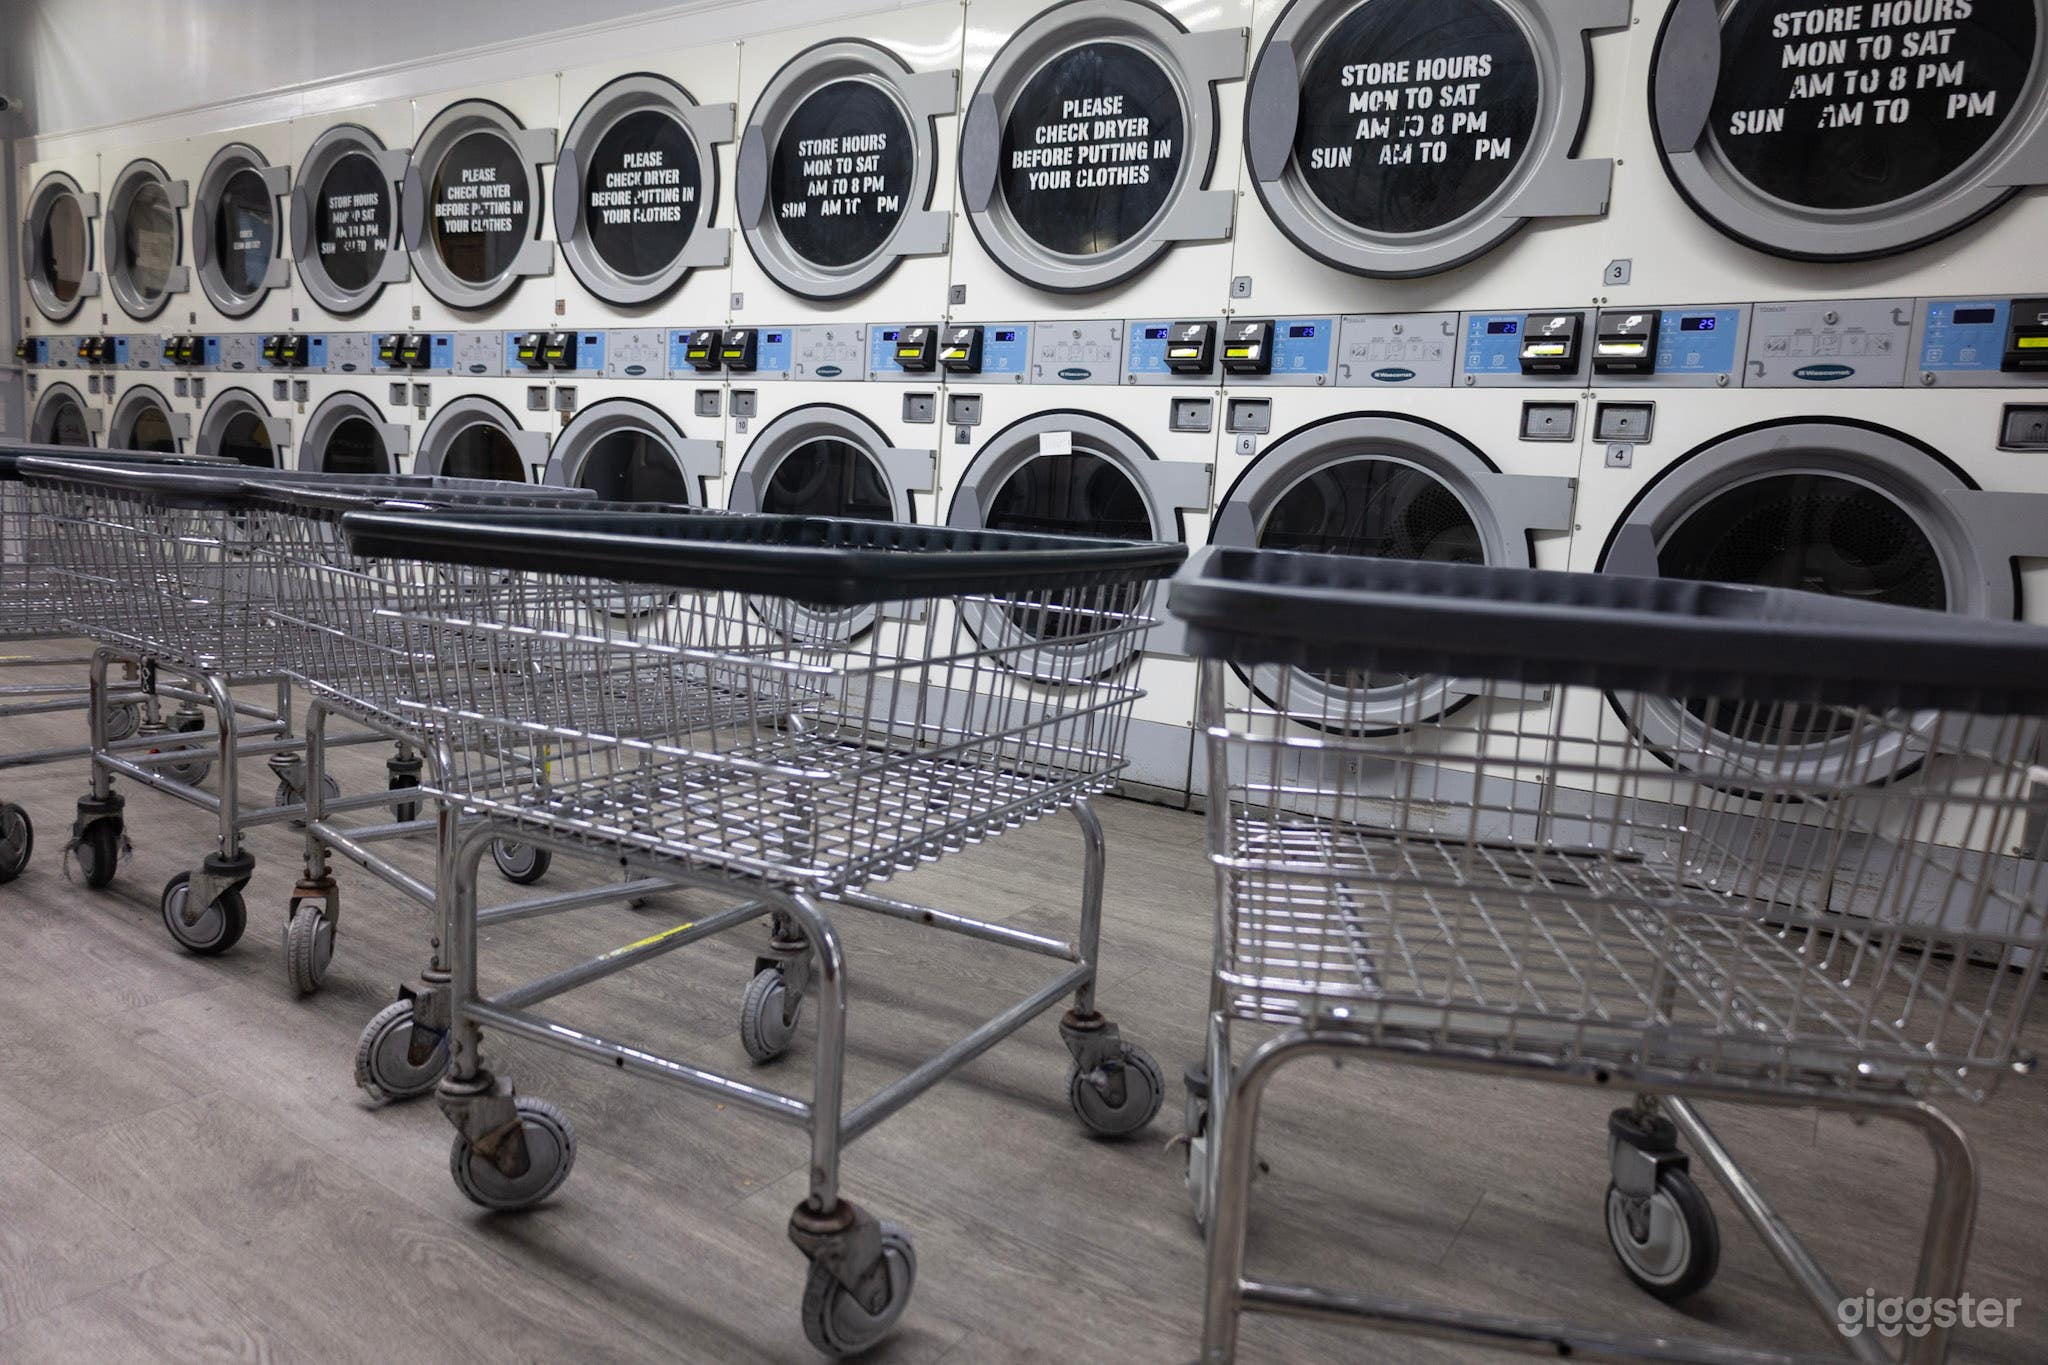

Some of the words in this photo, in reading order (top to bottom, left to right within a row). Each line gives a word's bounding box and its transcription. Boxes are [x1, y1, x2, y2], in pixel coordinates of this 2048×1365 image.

[1772, 5, 1863, 38] STORE
[1871, 0, 1972, 29] HOURS
[1781, 39, 1847, 69] MON
[1856, 34, 1892, 61] TO
[1900, 27, 1956, 58] SAT
[1341, 60, 1410, 87] STORE
[1416, 54, 1492, 81] HOURS
[1789, 72, 1835, 100] AM
[1844, 68, 1879, 95] TO
[1890, 66, 1907, 91] 8
[1916, 60, 1965, 89] PM
[1349, 88, 1399, 113] MON
[1405, 86, 1433, 110] TO
[1439, 83, 1481, 108] SAT
[1063, 96, 1124, 119] PLEASE
[1729, 108, 1784, 136] SUN
[1817, 102, 1864, 128] AM
[1873, 98, 1910, 125] TO
[1946, 90, 1996, 119] PM
[1035, 122, 1089, 145] CHECK
[1093, 117, 1150, 140] DRYER
[1355, 117, 1390, 140] AM
[1431, 113, 1445, 136] 8
[1451, 110, 1488, 135] PM
[798, 137, 839, 157] STORE
[842, 133, 887, 154] HOURS
[1310, 146, 1352, 169] SUN
[1378, 143, 1412, 165] AM
[1419, 141, 1447, 163] TO
[1475, 137, 1511, 161] PM
[623, 151, 663, 169] PLEASE
[1012, 147, 1073, 169] BEFORE
[1077, 141, 1149, 165] PUTTING
[1153, 139, 1172, 159] IN
[803, 159, 833, 177] MON
[836, 157, 853, 174] TO
[856, 155, 880, 173] SAT
[462, 168, 496, 183] PLEASE
[606, 171, 642, 188] CHECK
[644, 169, 680, 186] DRYER
[1029, 170, 1071, 191] YOUR
[1076, 165, 1150, 188] CLOTHES
[447, 185, 478, 200] CHECK
[480, 184, 510, 198] DRYER
[807, 180, 828, 197] AM
[832, 178, 848, 195] TO
[851, 177, 860, 194] 8
[863, 175, 885, 193] PM
[353, 192, 379, 207] HOURS
[591, 190, 632, 207] BEFORE
[682, 186, 694, 202] IN
[361, 208, 376, 221] SAT
[435, 203, 470, 217] BEFORE
[512, 200, 523, 214] IN
[603, 209, 631, 224] YOUR
[633, 206, 681, 223] CLOTHES
[781, 201, 807, 218] SUN
[821, 199, 841, 216] AM
[877, 195, 899, 213] PM
[366, 223, 378, 236] PM
[444, 219, 469, 233] YOUR
[471, 217, 512, 232] CLOTHES
[374, 238, 387, 251] PM
[1614, 267, 1622, 278] 3
[956, 290, 961, 298] 7
[1239, 282, 1245, 292] 5
[1303, 328, 1314, 336] 25
[1503, 323, 1516, 333] 25
[1699, 319, 1714, 329] 25
[1005, 333, 1014, 341] 25
[1156, 330, 1167, 338] 25
[739, 421, 745, 429] 10
[960, 430, 966, 439] 8
[1243, 440, 1249, 449] 6
[1615, 450, 1624, 460] 4
